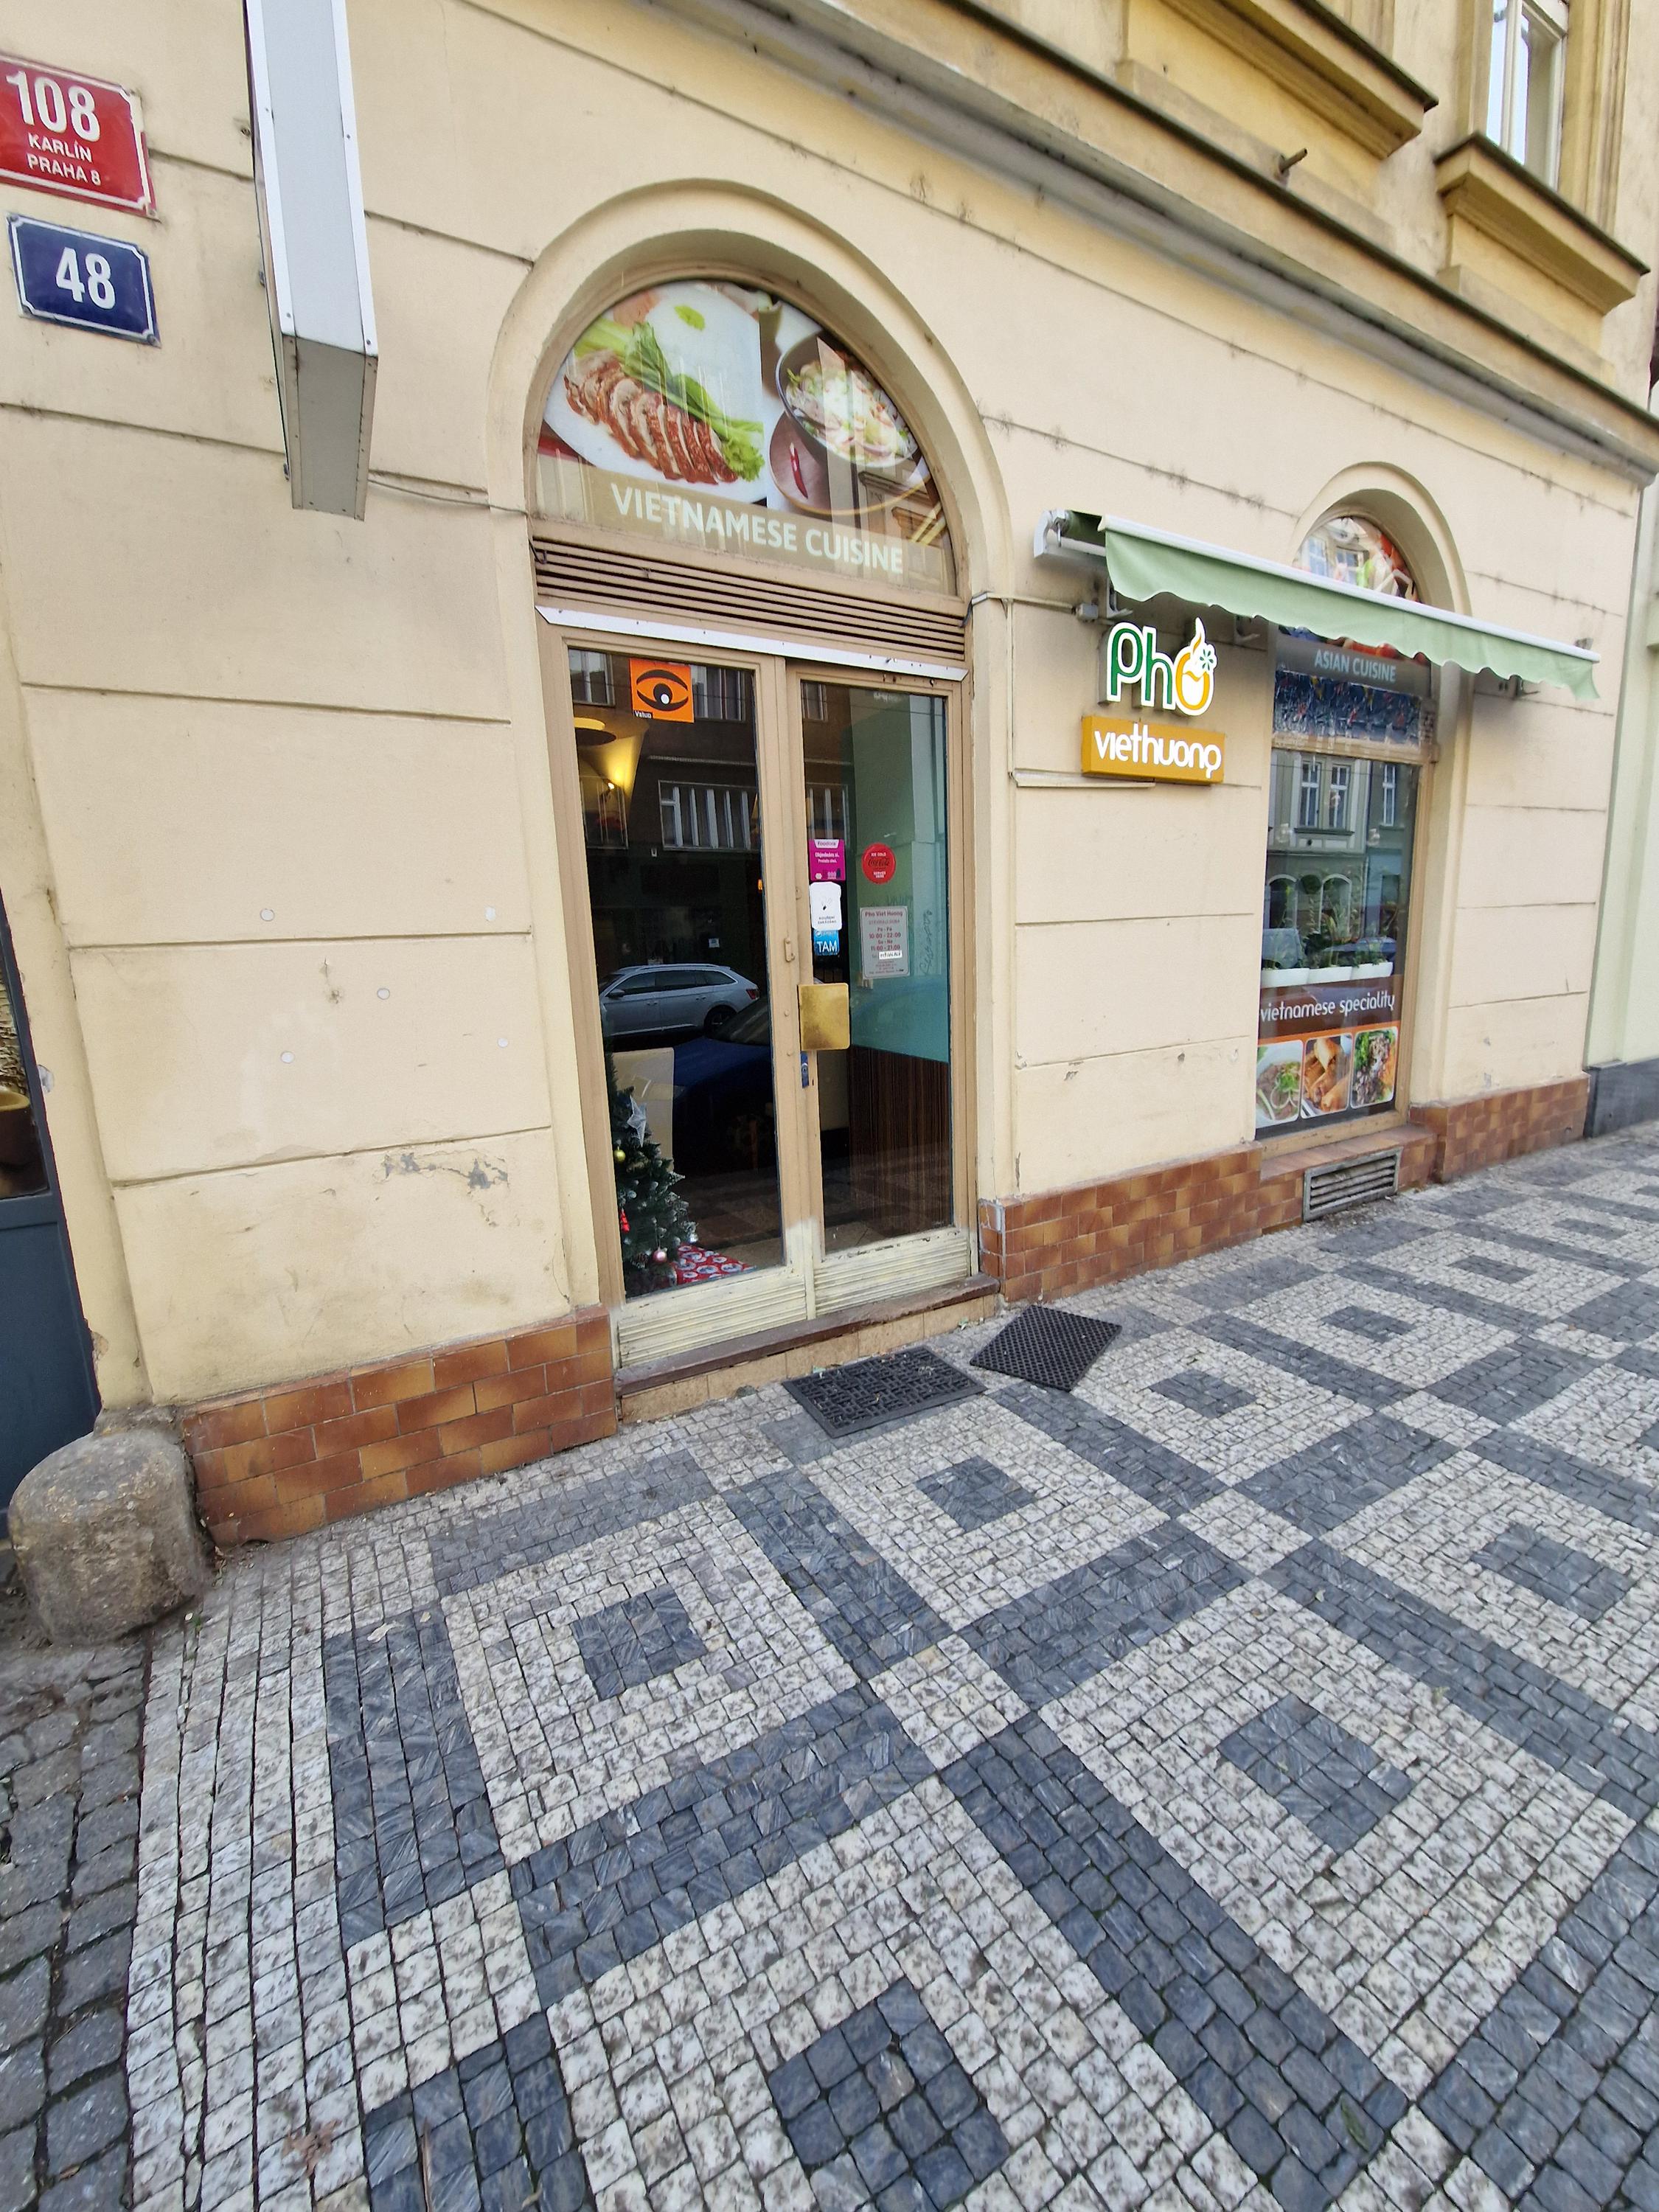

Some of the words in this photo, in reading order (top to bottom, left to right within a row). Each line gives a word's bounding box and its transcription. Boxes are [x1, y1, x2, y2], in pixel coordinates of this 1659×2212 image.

[6, 71, 100, 142] 108
[28, 132, 92, 163] KARLÍN
[27, 153, 88, 184] PRAHA
[91, 169, 101, 186] 8
[56, 247, 116, 310] 48
[611, 483, 797, 552] VIETNAMESE
[805, 528, 903, 575] CUISINE
[1314, 649, 1349, 674] ASIAN
[1352, 658, 1397, 683] CUISINE
[634, 710, 652, 719] Vstup
[1094, 723, 1222, 779] viethuong
[816, 940, 838, 953] TAM
[1259, 1001, 1336, 1022] vietnamese
[1339, 990, 1395, 1018] speciality
